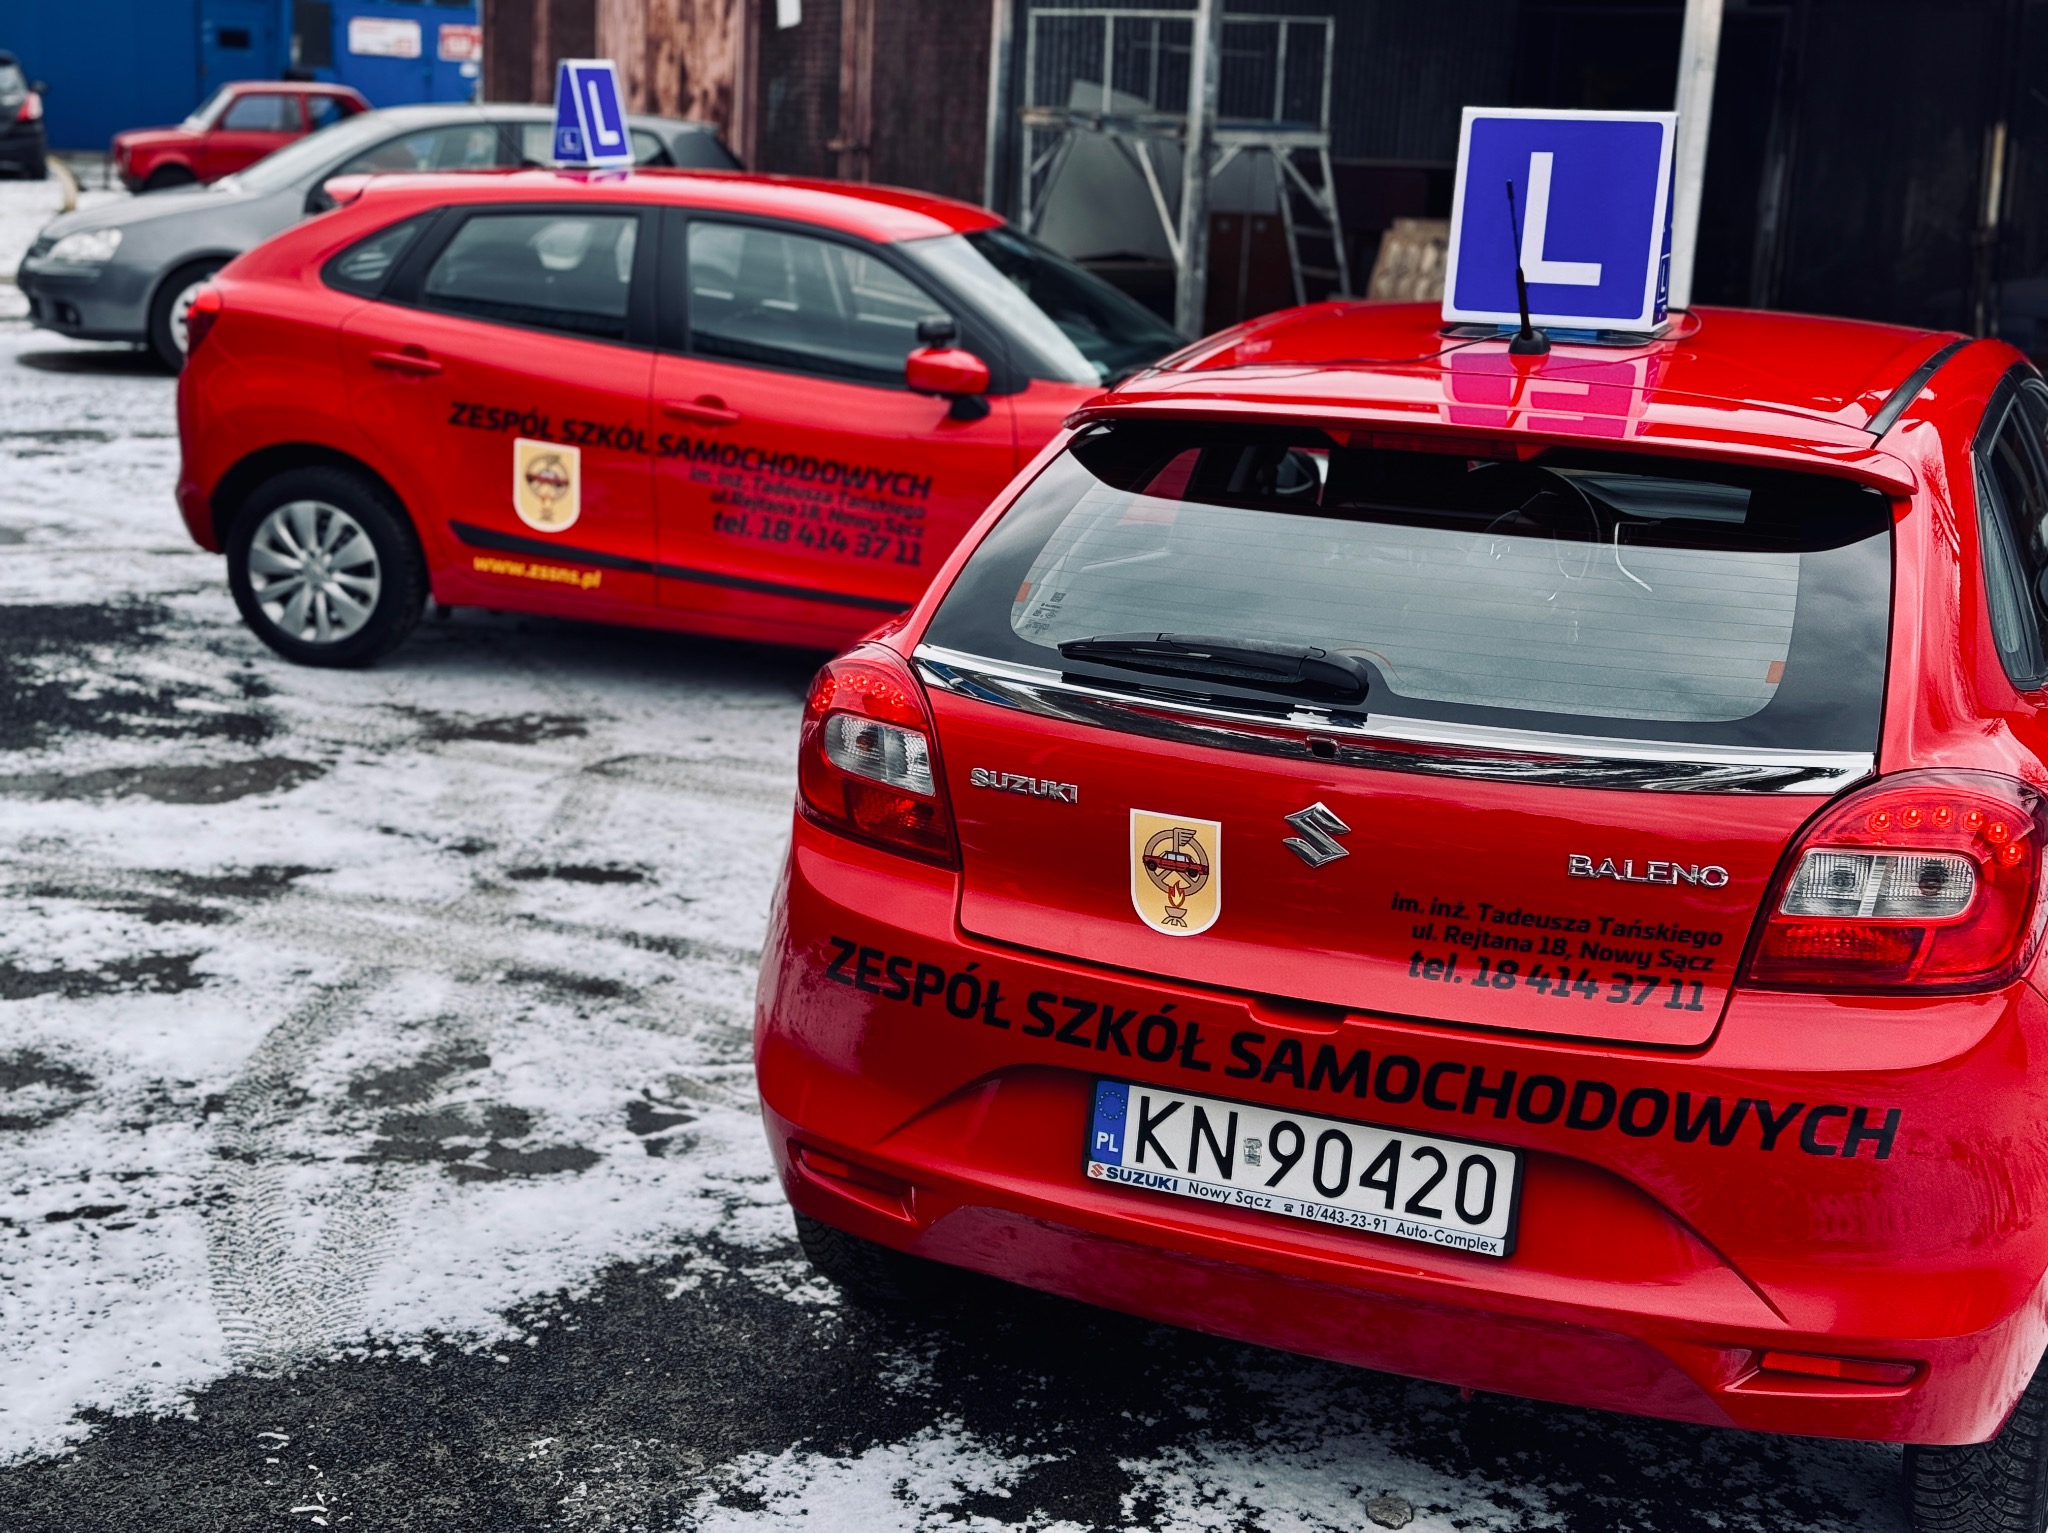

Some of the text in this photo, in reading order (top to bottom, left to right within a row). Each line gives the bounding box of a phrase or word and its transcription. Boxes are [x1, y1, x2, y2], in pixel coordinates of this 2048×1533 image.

[586, 80, 620, 146] L
[1519, 151, 1602, 286] L
[657, 433, 933, 499] SAMOCHODOWYCH
[713, 510, 922, 567] tel. 18 414 37 11
[970, 767, 1079, 804] SUZUKI
[1567, 853, 1730, 888] BALENO
[1391, 892, 1723, 948] im. inż. Tadeusza Tańskiego
[1411, 922, 1716, 972] ul. Rejtana 18, Nowy Sącz
[1409, 950, 1706, 1012] tel. 18 414 37 11
[824, 935, 1902, 1160] ZESPÓŁ SZKÓŁ SAMOCHODOWYCH
[1095, 1132, 1119, 1153] PL
[1135, 1096, 1498, 1225] KN 90420
[1105, 1166, 1499, 1254] SUZUKI Nowy Sącz 18/443-23-91 Auto-Complex
